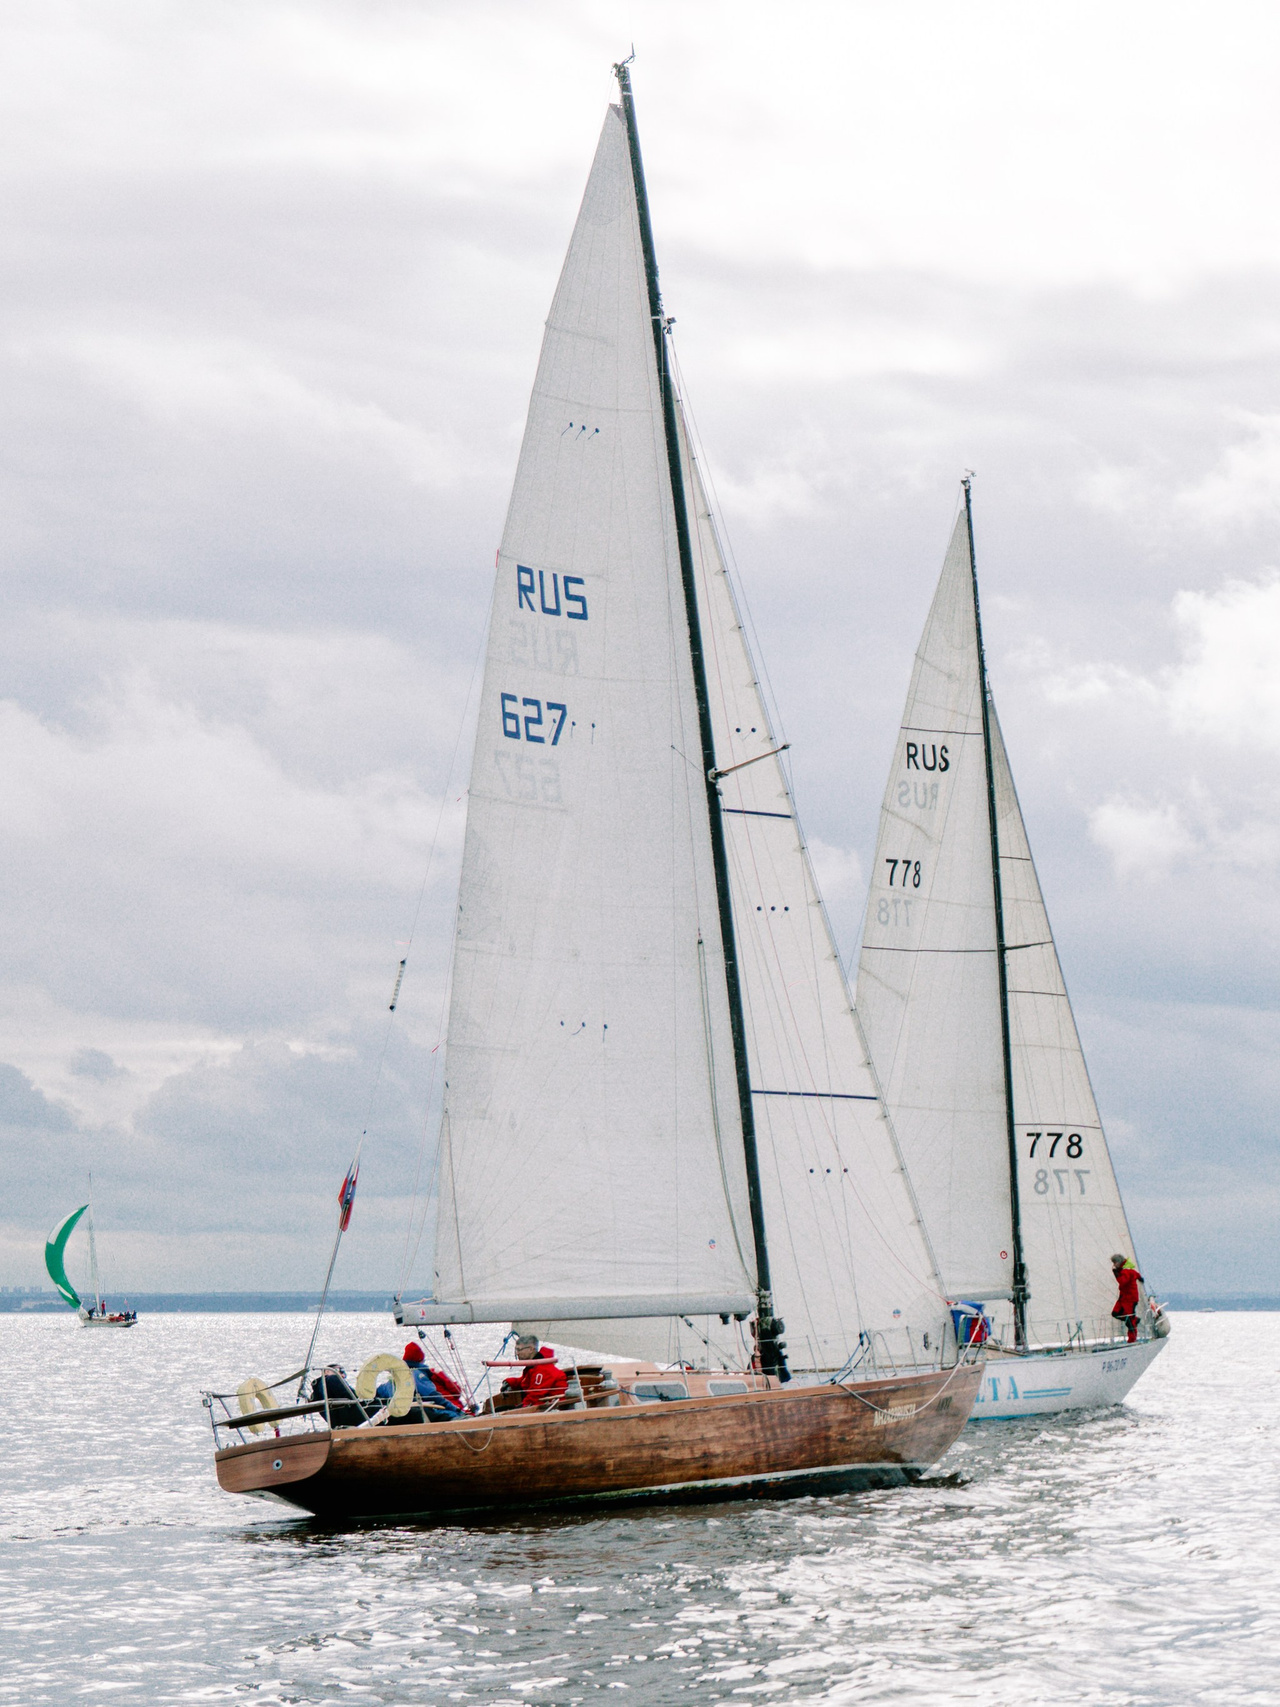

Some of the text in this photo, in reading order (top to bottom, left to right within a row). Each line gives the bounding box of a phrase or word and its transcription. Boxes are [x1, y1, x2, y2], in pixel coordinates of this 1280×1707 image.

[516, 563, 589, 621] RUS
[500, 692, 568, 746] 627
[906, 741, 950, 772] RUS
[885, 858, 922, 888] 778
[1026, 1132, 1083, 1159] 778
